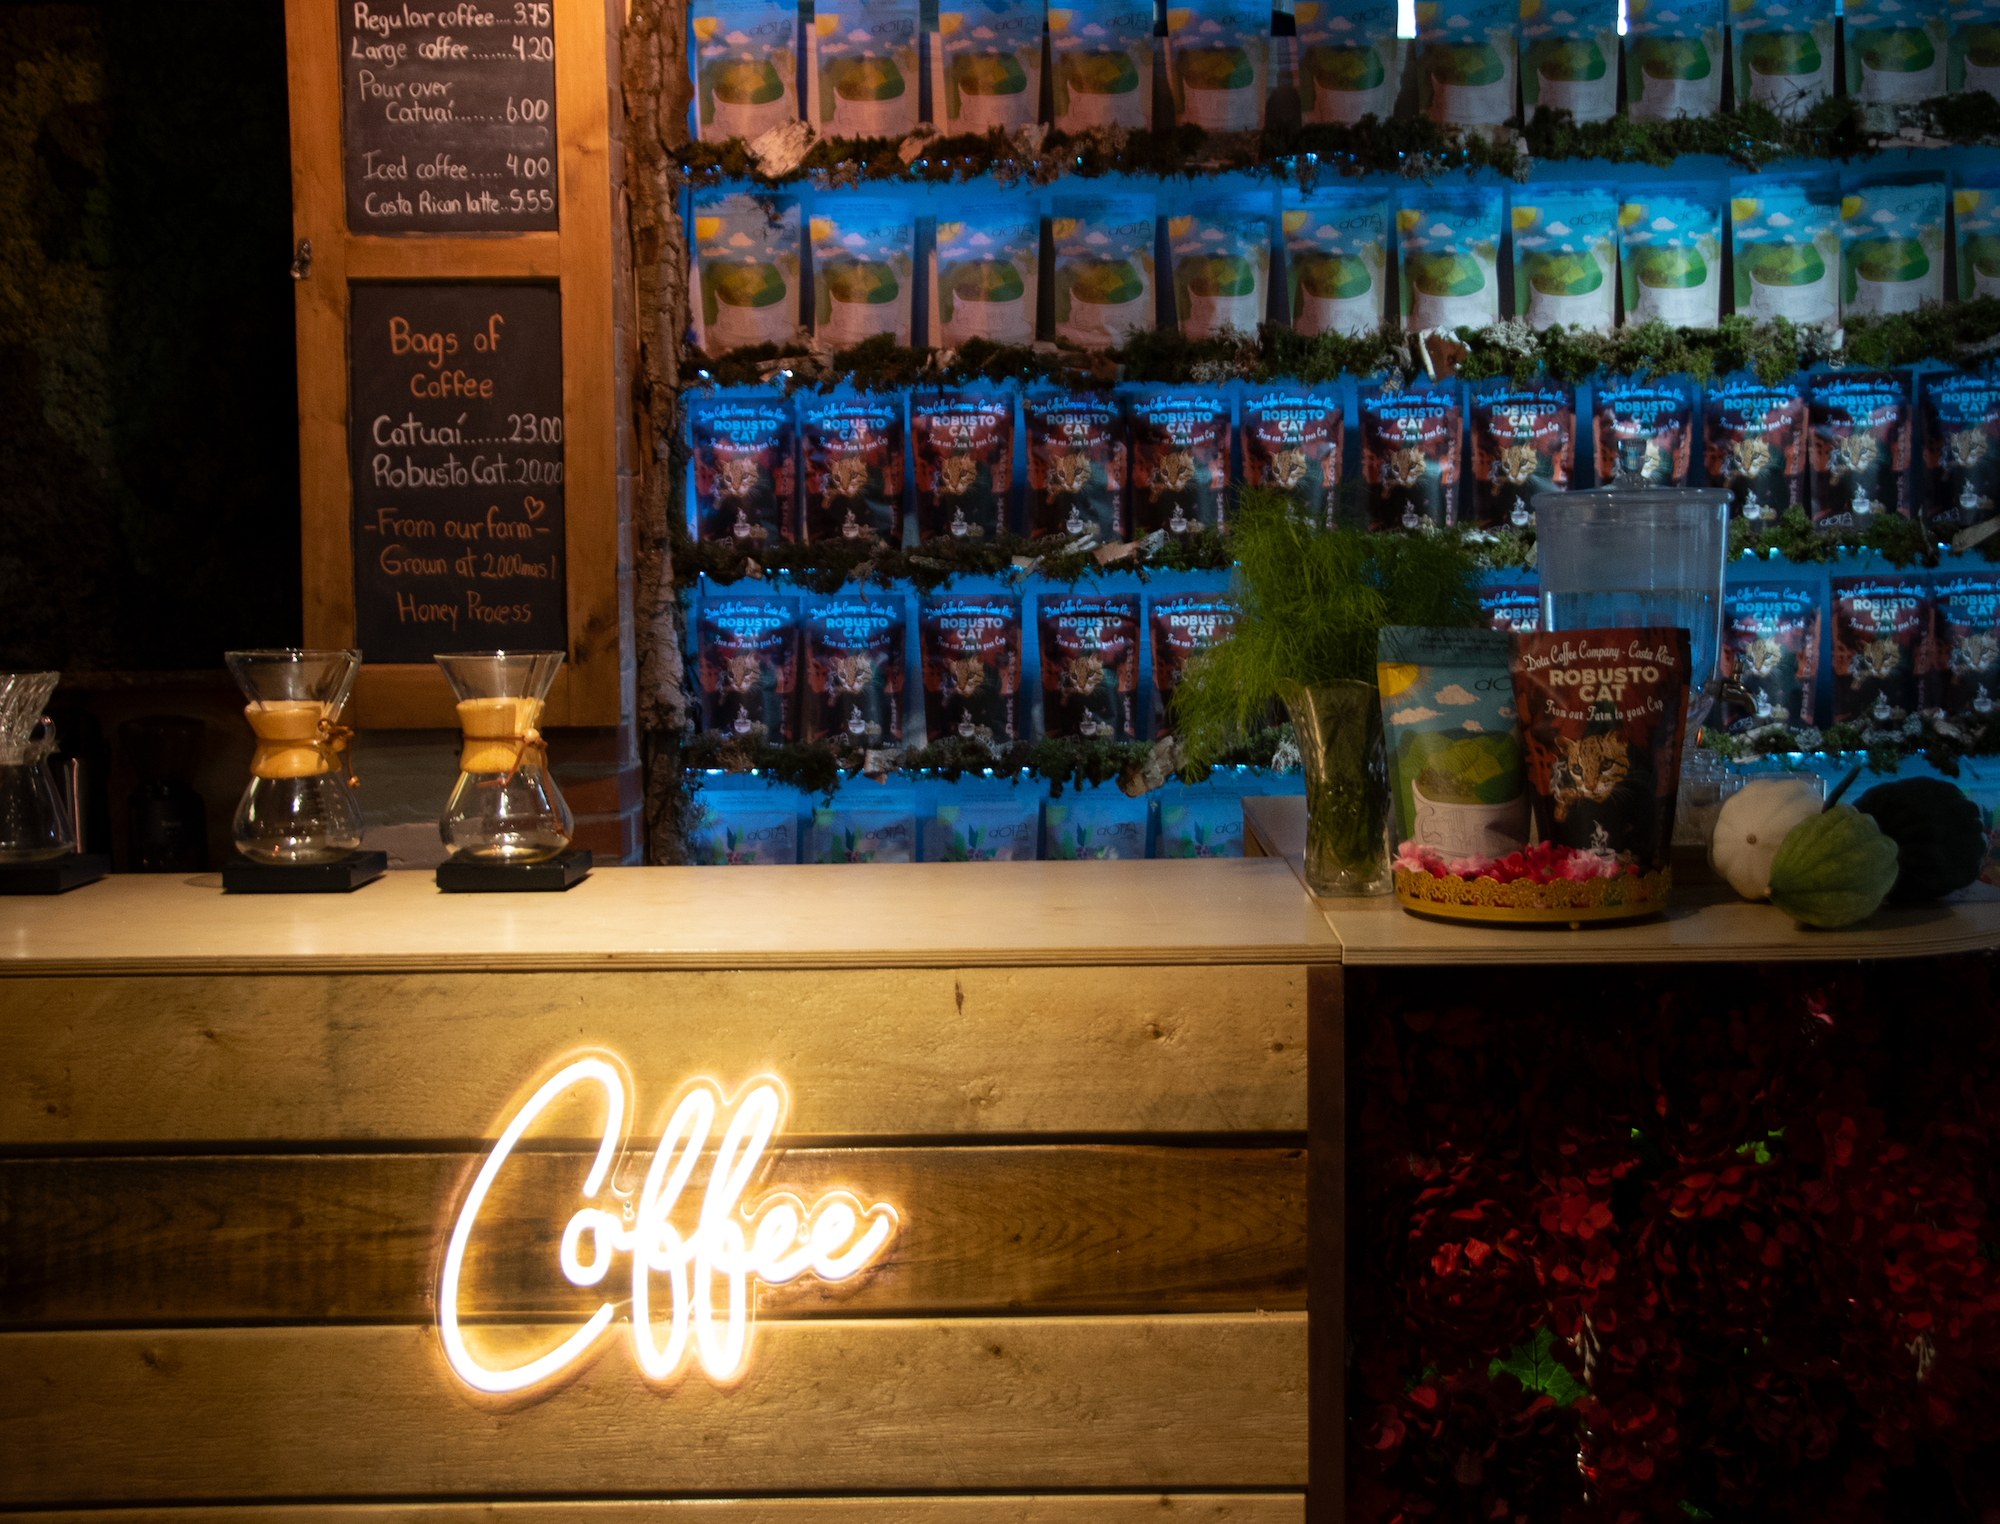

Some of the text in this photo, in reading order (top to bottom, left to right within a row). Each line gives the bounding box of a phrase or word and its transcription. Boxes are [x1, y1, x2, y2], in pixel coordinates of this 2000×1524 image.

[354, 1, 435, 38] Regular
[351, 36, 408, 68] Large
[360, 69, 452, 102] Pour over
[362, 149, 408, 180] Iced
[365, 192, 413, 217] Costa
[419, 190, 462, 214] Rican
[388, 313, 505, 370] Bags of
[410, 369, 494, 398] Coffee
[1828, 393, 1894, 407] ROBUSTO
[1942, 390, 2000, 403] ROBUST
[1492, 404, 1556, 416] ROBUSTO
[1614, 401, 1676, 412] ROBUSTO
[1846, 405, 1874, 416] CAT
[1958, 401, 1987, 412] CAT
[1046, 413, 1109, 425] ROBUSTO
[1150, 412, 1212, 423] ROBUSTO
[1261, 409, 1325, 421] ROBUSTO
[1380, 407, 1444, 419] ROBUSTO
[713, 419, 777, 431] ROBUSTO
[823, 419, 886, 430] ROBUSTO
[932, 415, 996, 427] ROBUSTO
[1278, 420, 1305, 431] CAT
[1397, 418, 1424, 429] CAT
[1509, 415, 1536, 426] CAT
[949, 426, 976, 437] CAT
[1063, 424, 1090, 435] CAT
[1166, 423, 1193, 433] CAT
[730, 430, 757, 441] CAT
[839, 429, 866, 440] CAT
[372, 452, 469, 488] Robusto
[444, 520, 484, 540] our
[380, 544, 448, 576] Grown
[455, 546, 478, 578] at
[1736, 602, 1801, 613] ROBUSTO
[1853, 598, 1917, 610] ROBUSTO
[397, 590, 532, 631] Honey Process
[1494, 607, 1540, 619] ROBUS
[1870, 609, 1897, 620] CAT
[1967, 605, 1995, 616] CAT
[718, 617, 781, 629] ROBUSTO
[826, 617, 888, 628] ROBUSTO
[940, 617, 1003, 629] ROBUSTO
[1059, 616, 1122, 628] ROBUSTO
[1511, 618, 1538, 629] CAT
[842, 628, 869, 638] CAT
[957, 628, 984, 639] CAT
[1076, 627, 1102, 638] CAT
[1187, 626, 1214, 636] CAT
[1523, 640, 1675, 672] Dota Coffee Company Costa Rica
[1549, 666, 1660, 686] ROBUSTO
[1578, 683, 1626, 702] CAT
[1544, 695, 1663, 722] From our Farm to your Cup
[440, 1058, 890, 1394] Coffee
